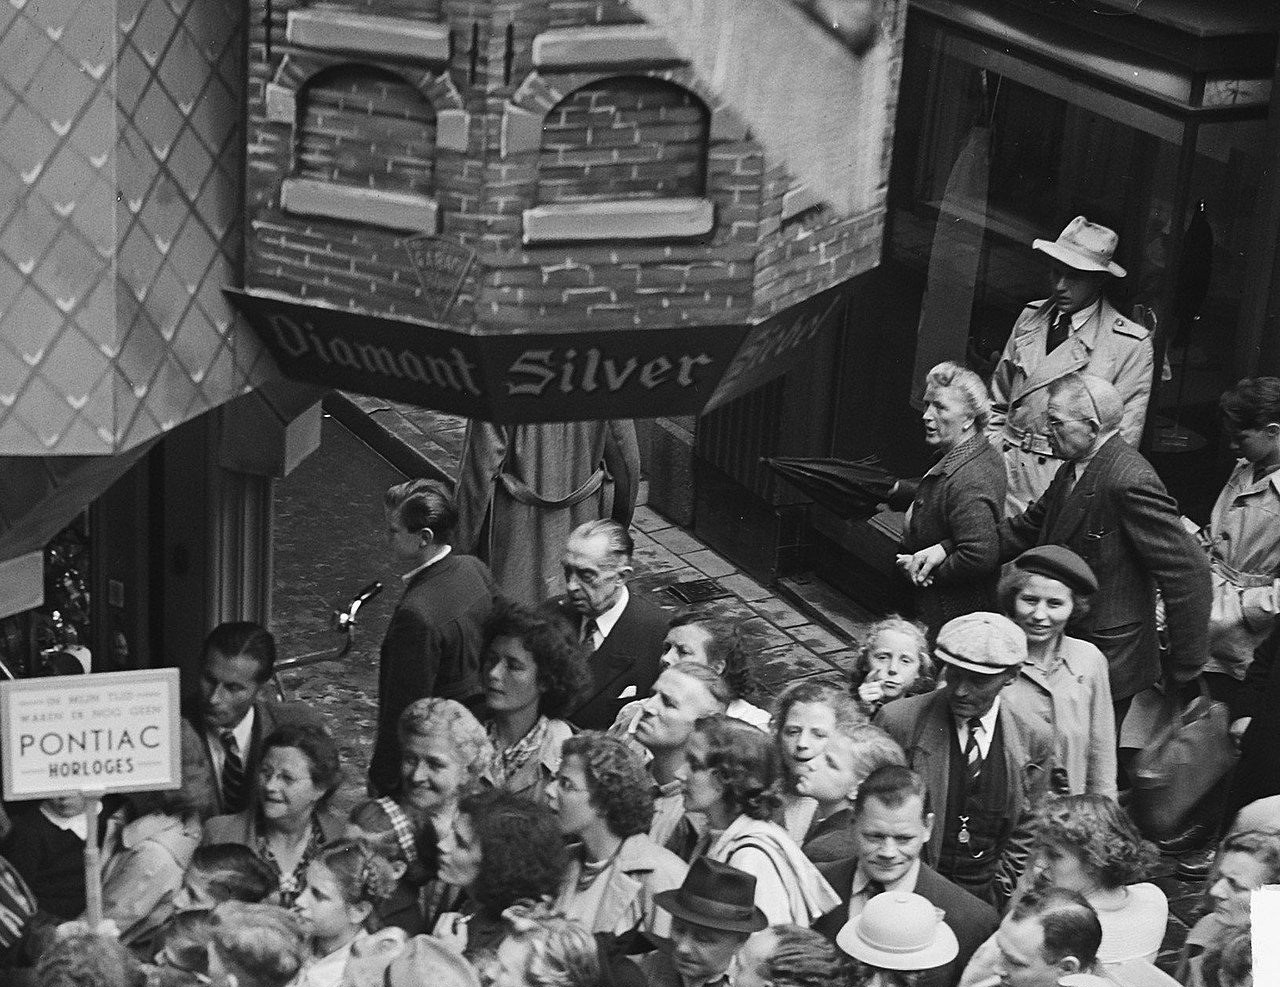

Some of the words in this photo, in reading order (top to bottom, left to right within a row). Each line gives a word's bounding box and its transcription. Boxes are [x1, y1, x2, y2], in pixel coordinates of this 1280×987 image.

[270, 313, 482, 396] Diamant
[506, 348, 713, 395] Silver
[20, 725, 160, 756] PONTIAC
[48, 758, 134, 777] HORLOGES
